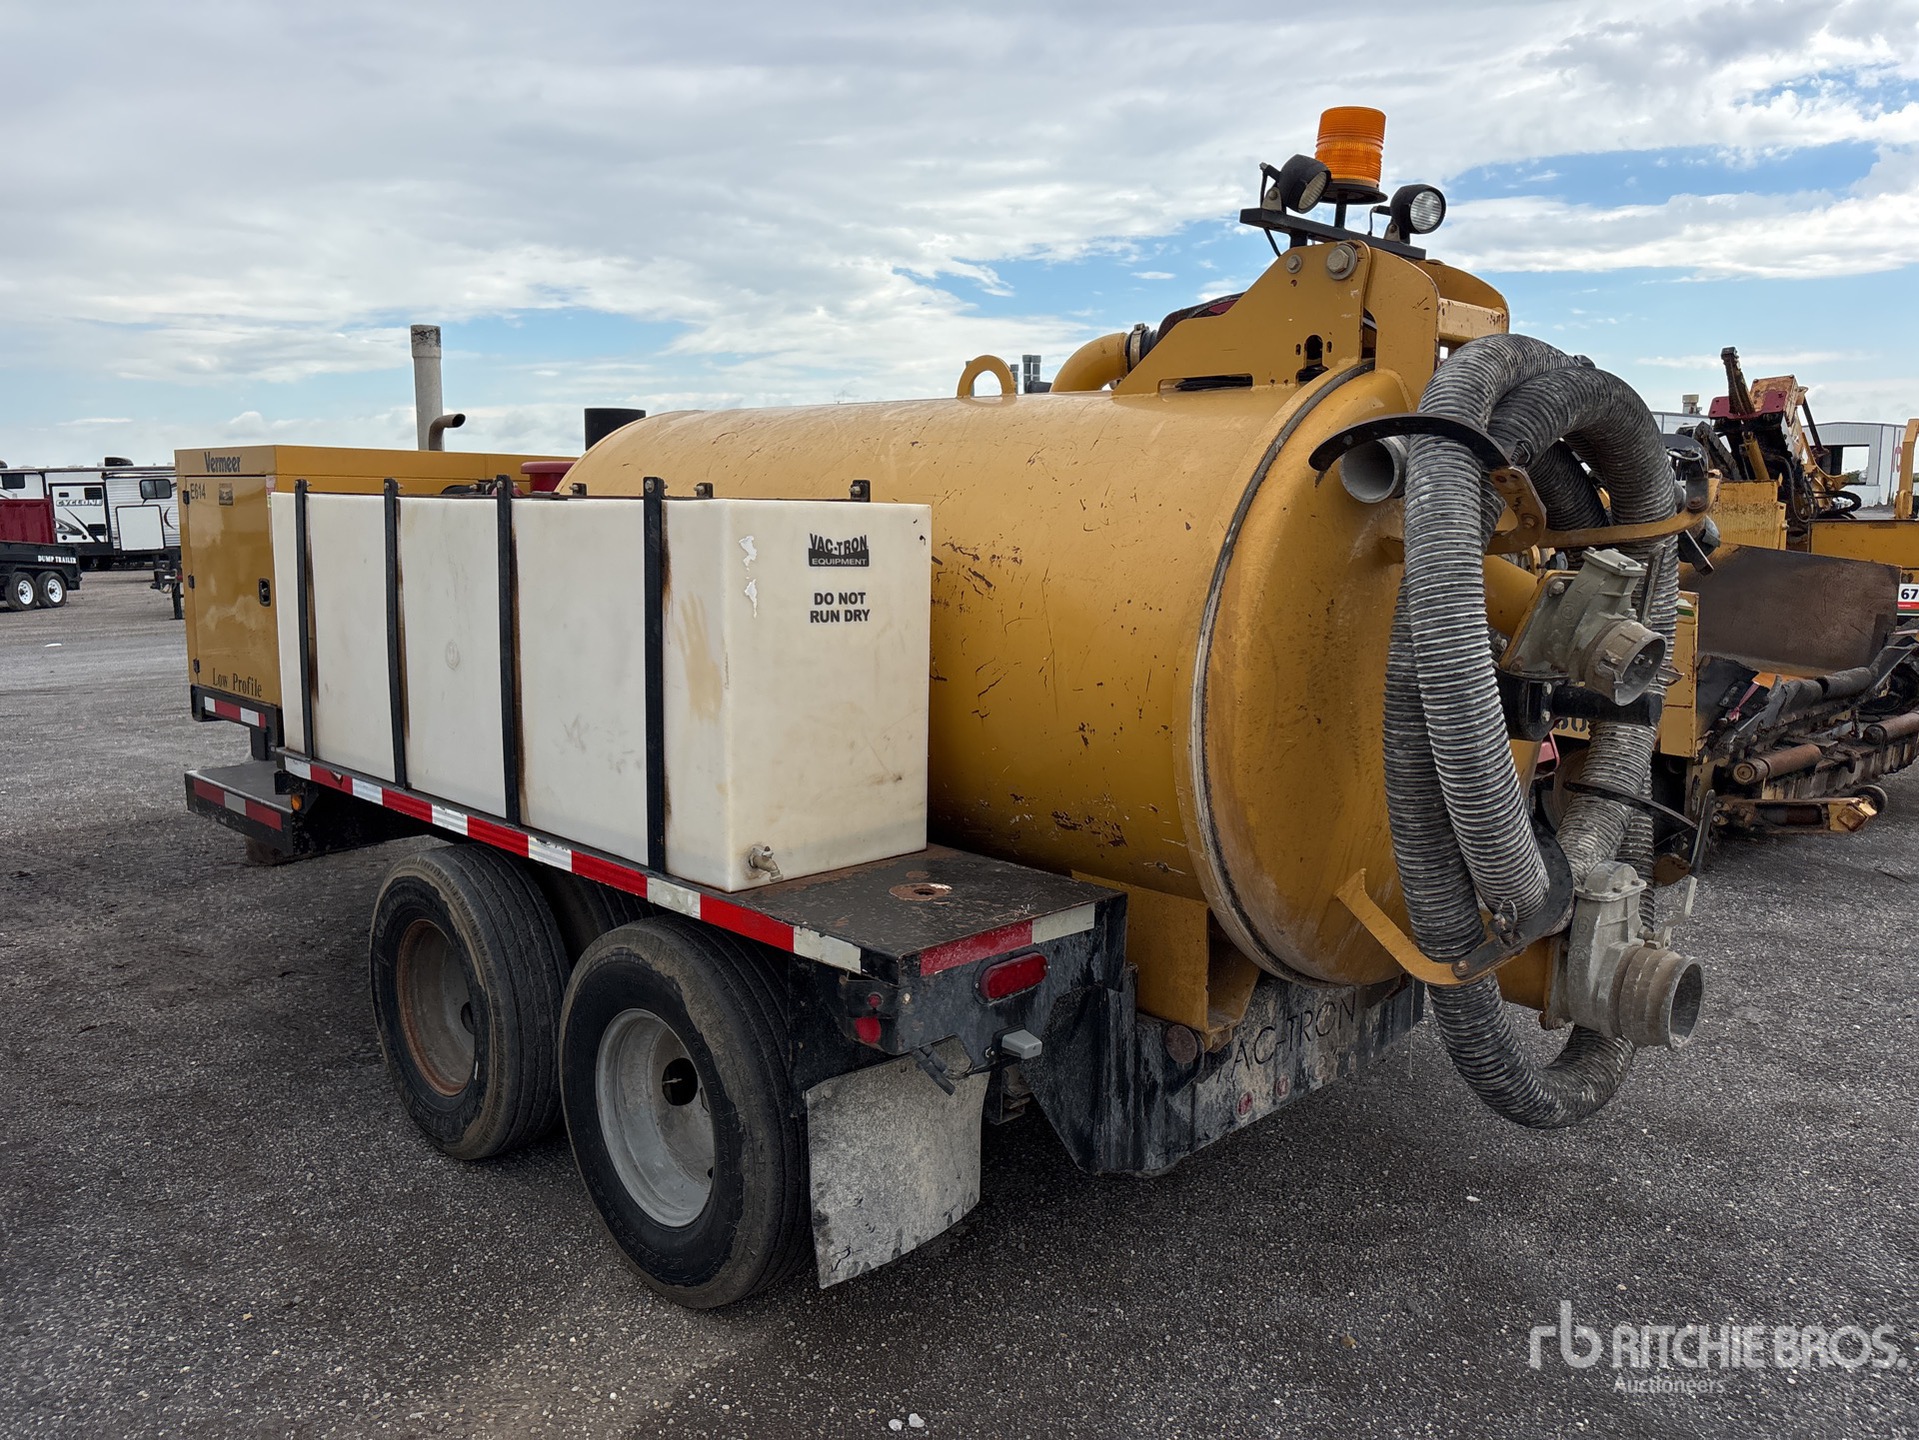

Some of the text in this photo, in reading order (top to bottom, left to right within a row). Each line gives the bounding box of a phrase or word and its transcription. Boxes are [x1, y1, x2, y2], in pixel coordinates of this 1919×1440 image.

[204, 451, 241, 473] Vermeer
[56, 499, 103, 507] CYCLONE
[37, 555, 77, 564] DUMP TRAILER
[814, 592, 866, 605] DO NOT
[810, 609, 870, 623] RUN DRY
[213, 667, 262, 697] Low Profile
